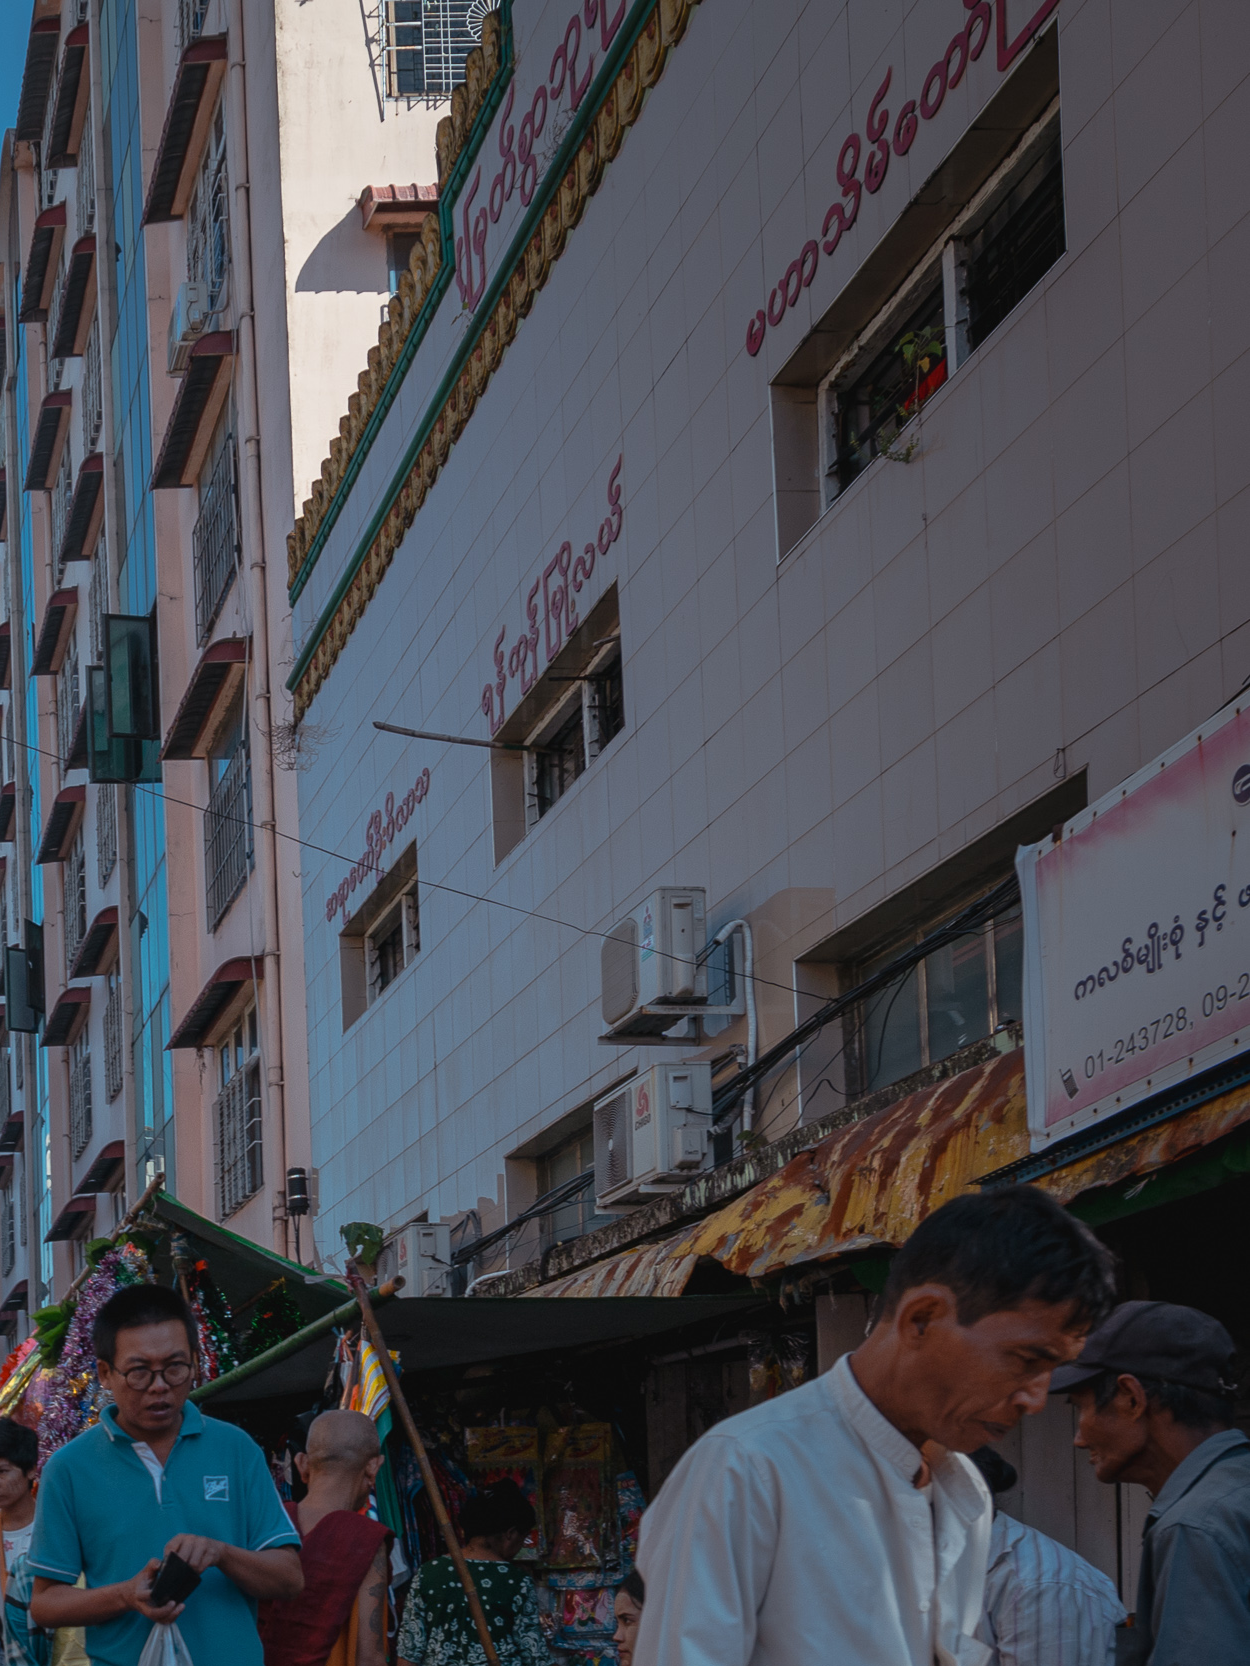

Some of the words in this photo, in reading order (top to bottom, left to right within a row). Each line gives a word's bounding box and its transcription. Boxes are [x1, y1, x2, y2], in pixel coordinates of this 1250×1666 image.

[746, 0, 1059, 357] မဟာသိမ်တော
[1085, 1006, 1194, 1079] 01-243728,
